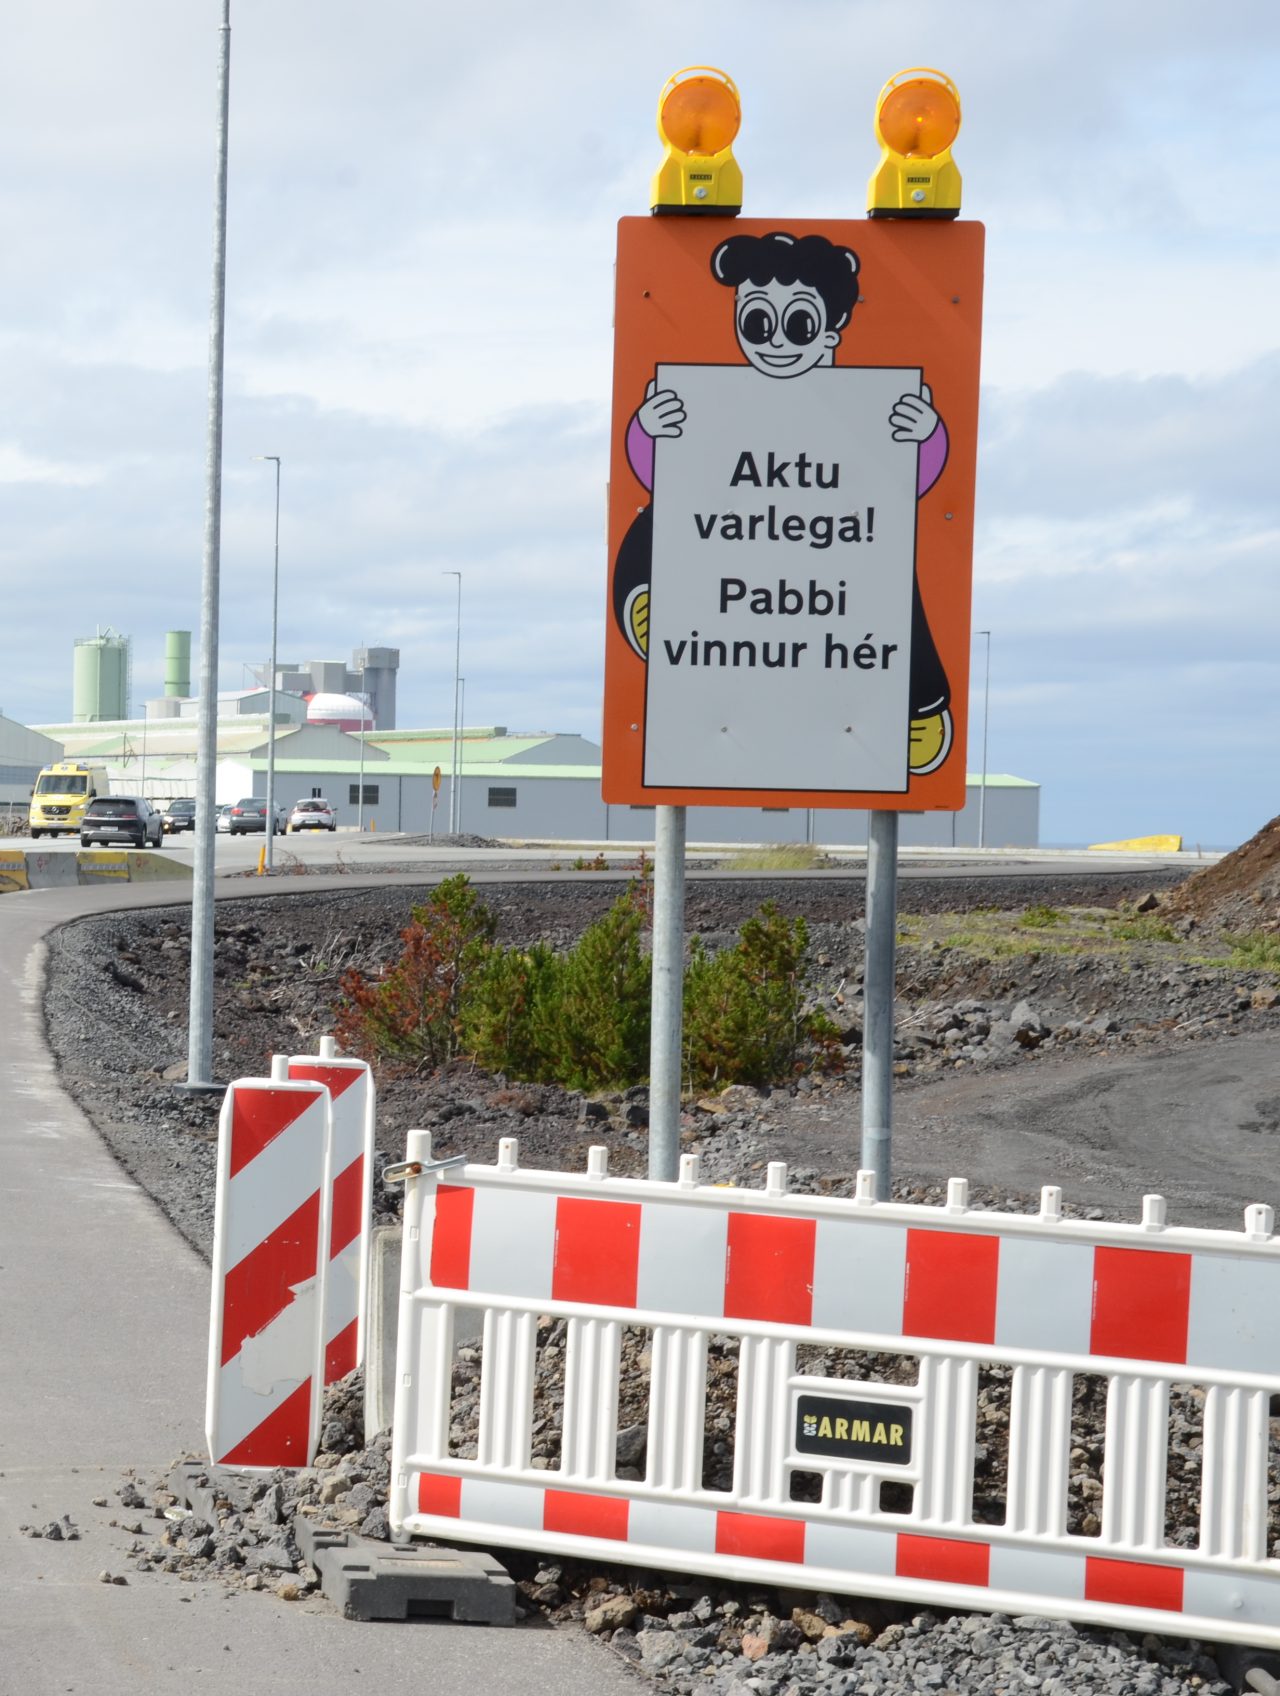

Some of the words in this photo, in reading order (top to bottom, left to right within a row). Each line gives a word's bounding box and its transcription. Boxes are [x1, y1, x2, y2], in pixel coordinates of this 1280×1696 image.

[730, 451, 840, 489] Aktu
[693, 505, 875, 549] varlega!
[719, 577, 847, 616] Pabbi
[663, 630, 808, 668] vinnur
[824, 632, 898, 670] hér
[817, 1416, 904, 1446] ARMAR
